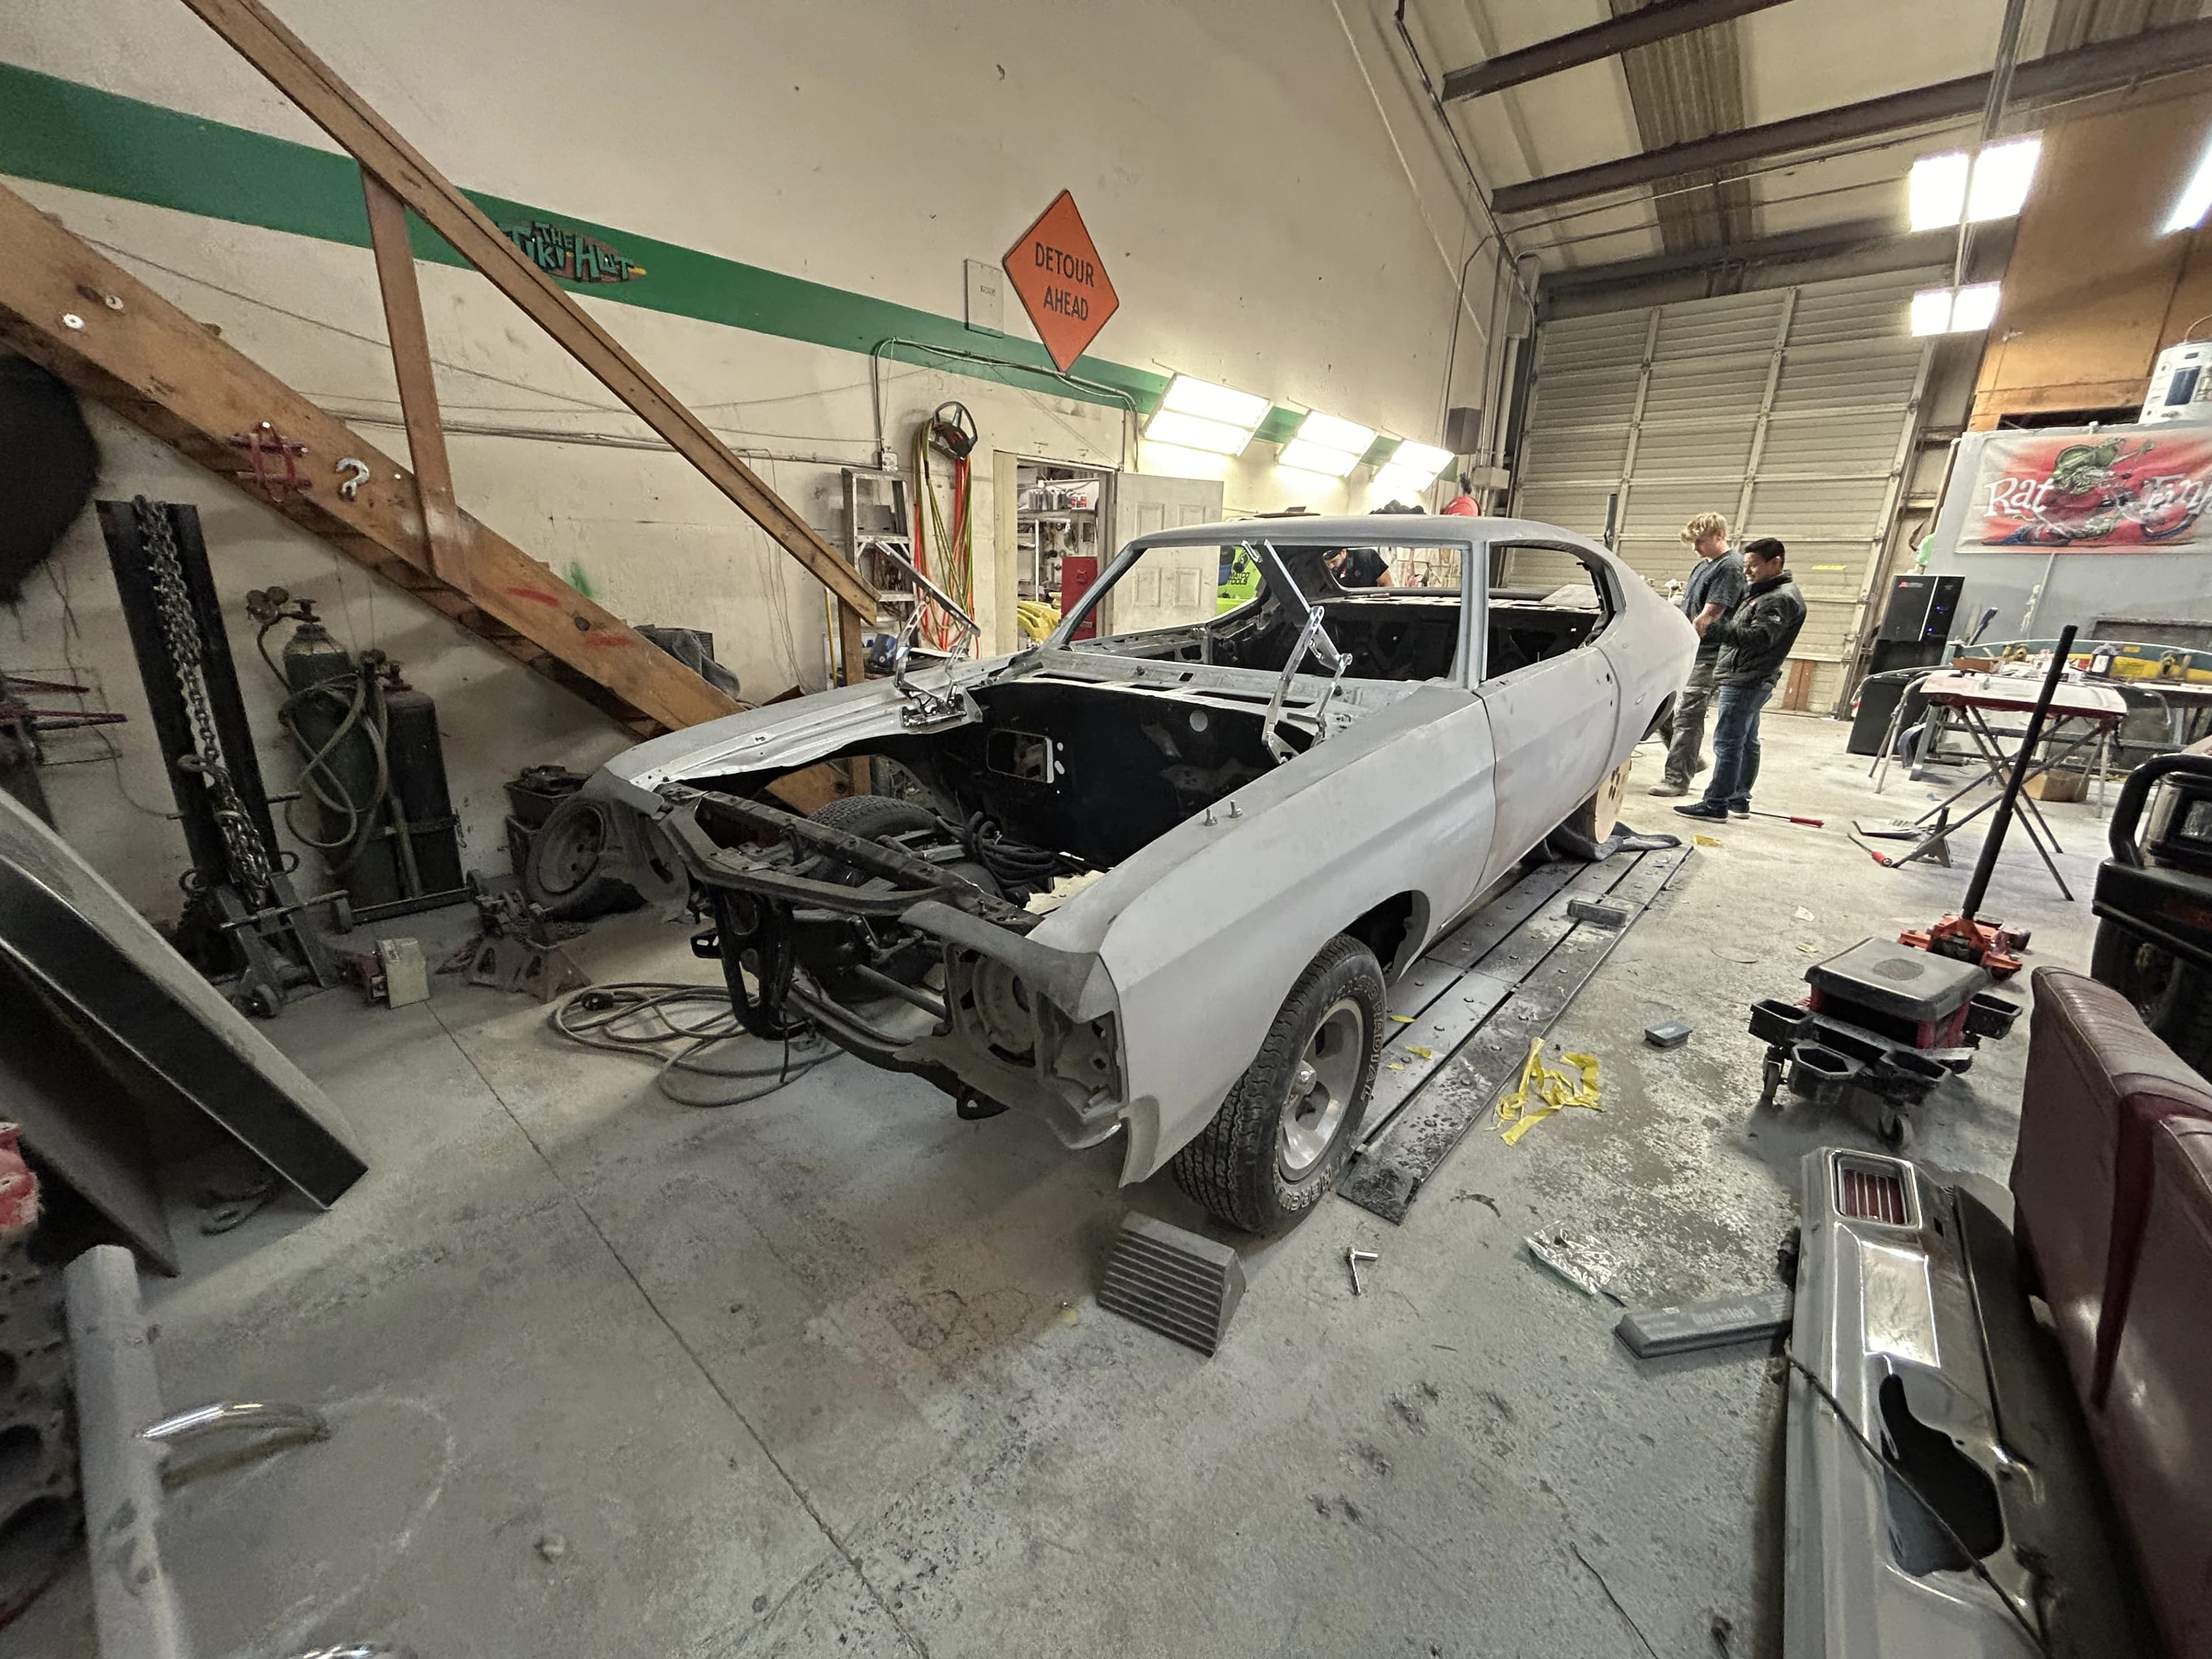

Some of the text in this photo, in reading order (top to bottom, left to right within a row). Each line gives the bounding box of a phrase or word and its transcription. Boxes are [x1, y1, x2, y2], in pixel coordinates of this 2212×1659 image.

[533, 222, 574, 249] THE
[574, 234, 634, 282] HUT
[1035, 241, 1094, 287] DETOUR
[1043, 285, 1089, 321] AHEAD
[1983, 476, 2055, 518] Rat
[1360, 1000, 1383, 1101] RADIAL
